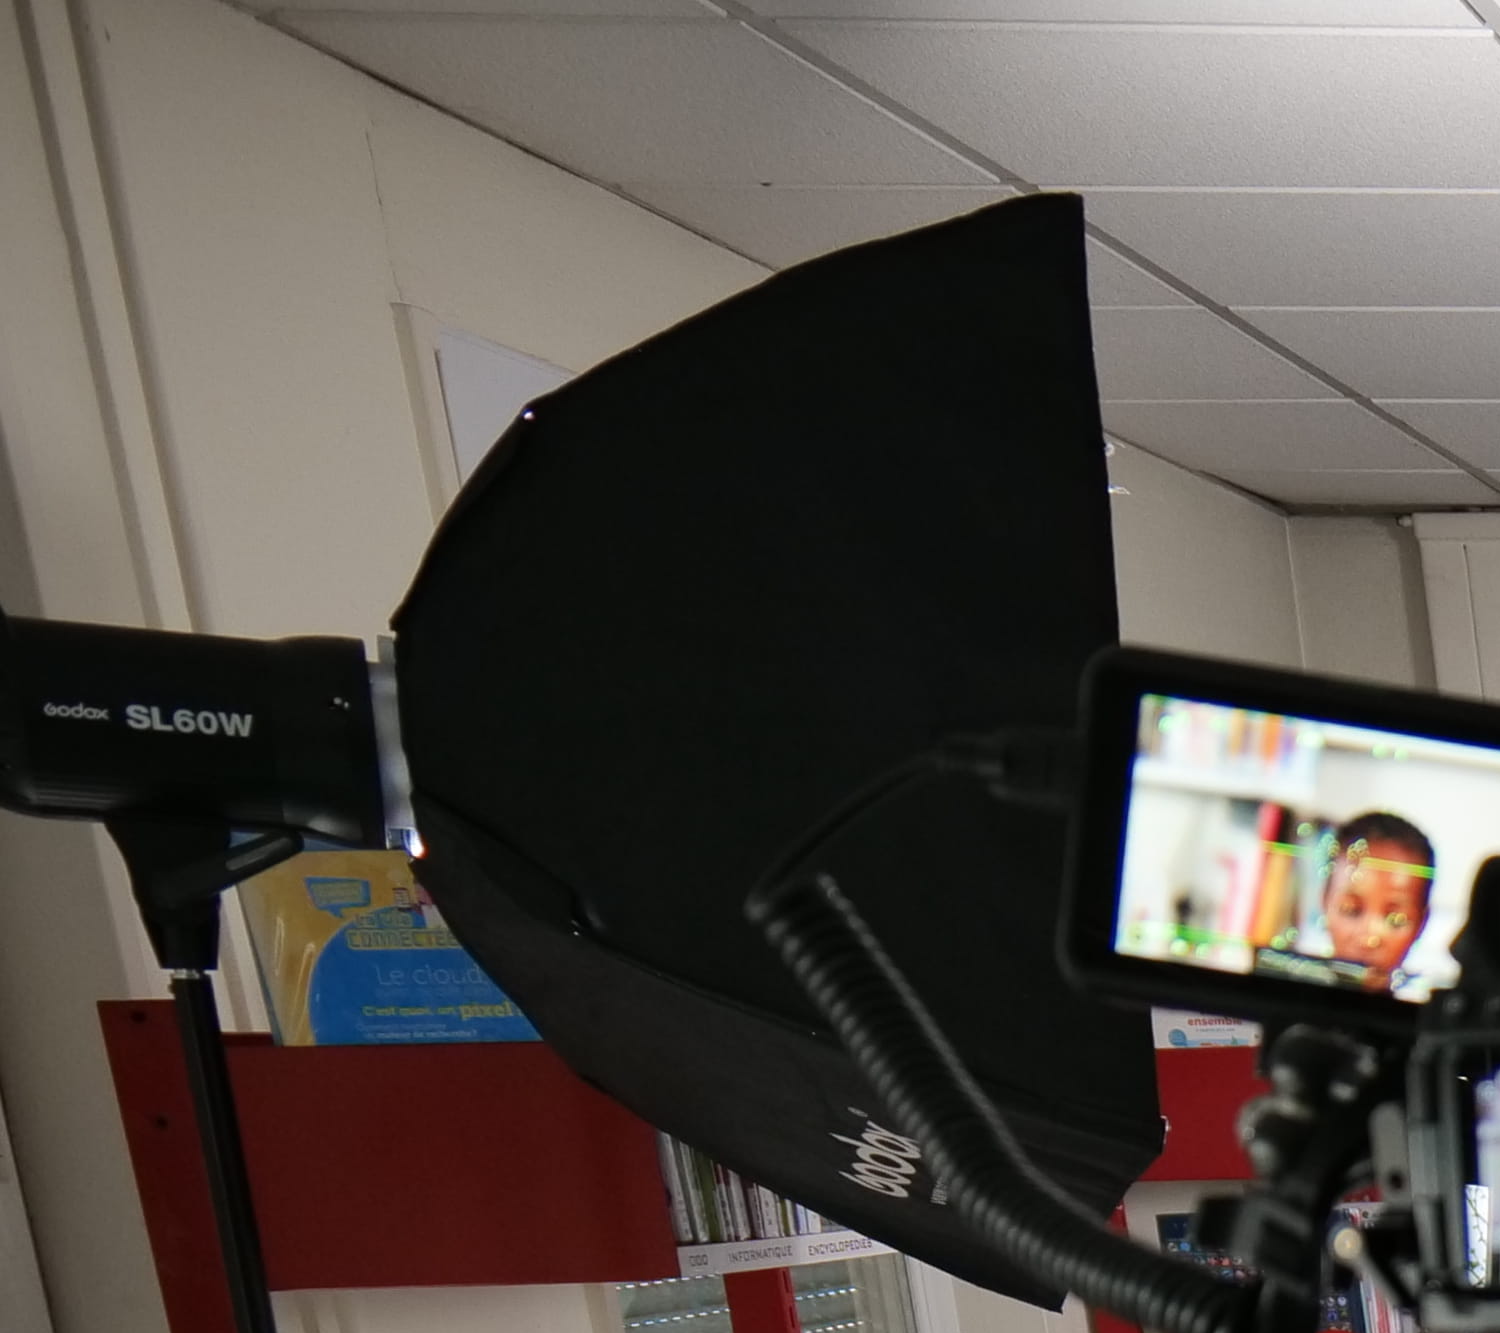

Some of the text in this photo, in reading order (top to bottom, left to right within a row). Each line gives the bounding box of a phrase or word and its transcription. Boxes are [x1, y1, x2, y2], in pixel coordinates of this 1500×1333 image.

[43, 702, 252, 737] Godox SL60W
[375, 963, 404, 986] Le
[458, 1000, 512, 1021] pixel
[727, 1244, 793, 1264] INFORMATIQUE
[808, 1237, 874, 1257] ENCYCLOPEDIES
